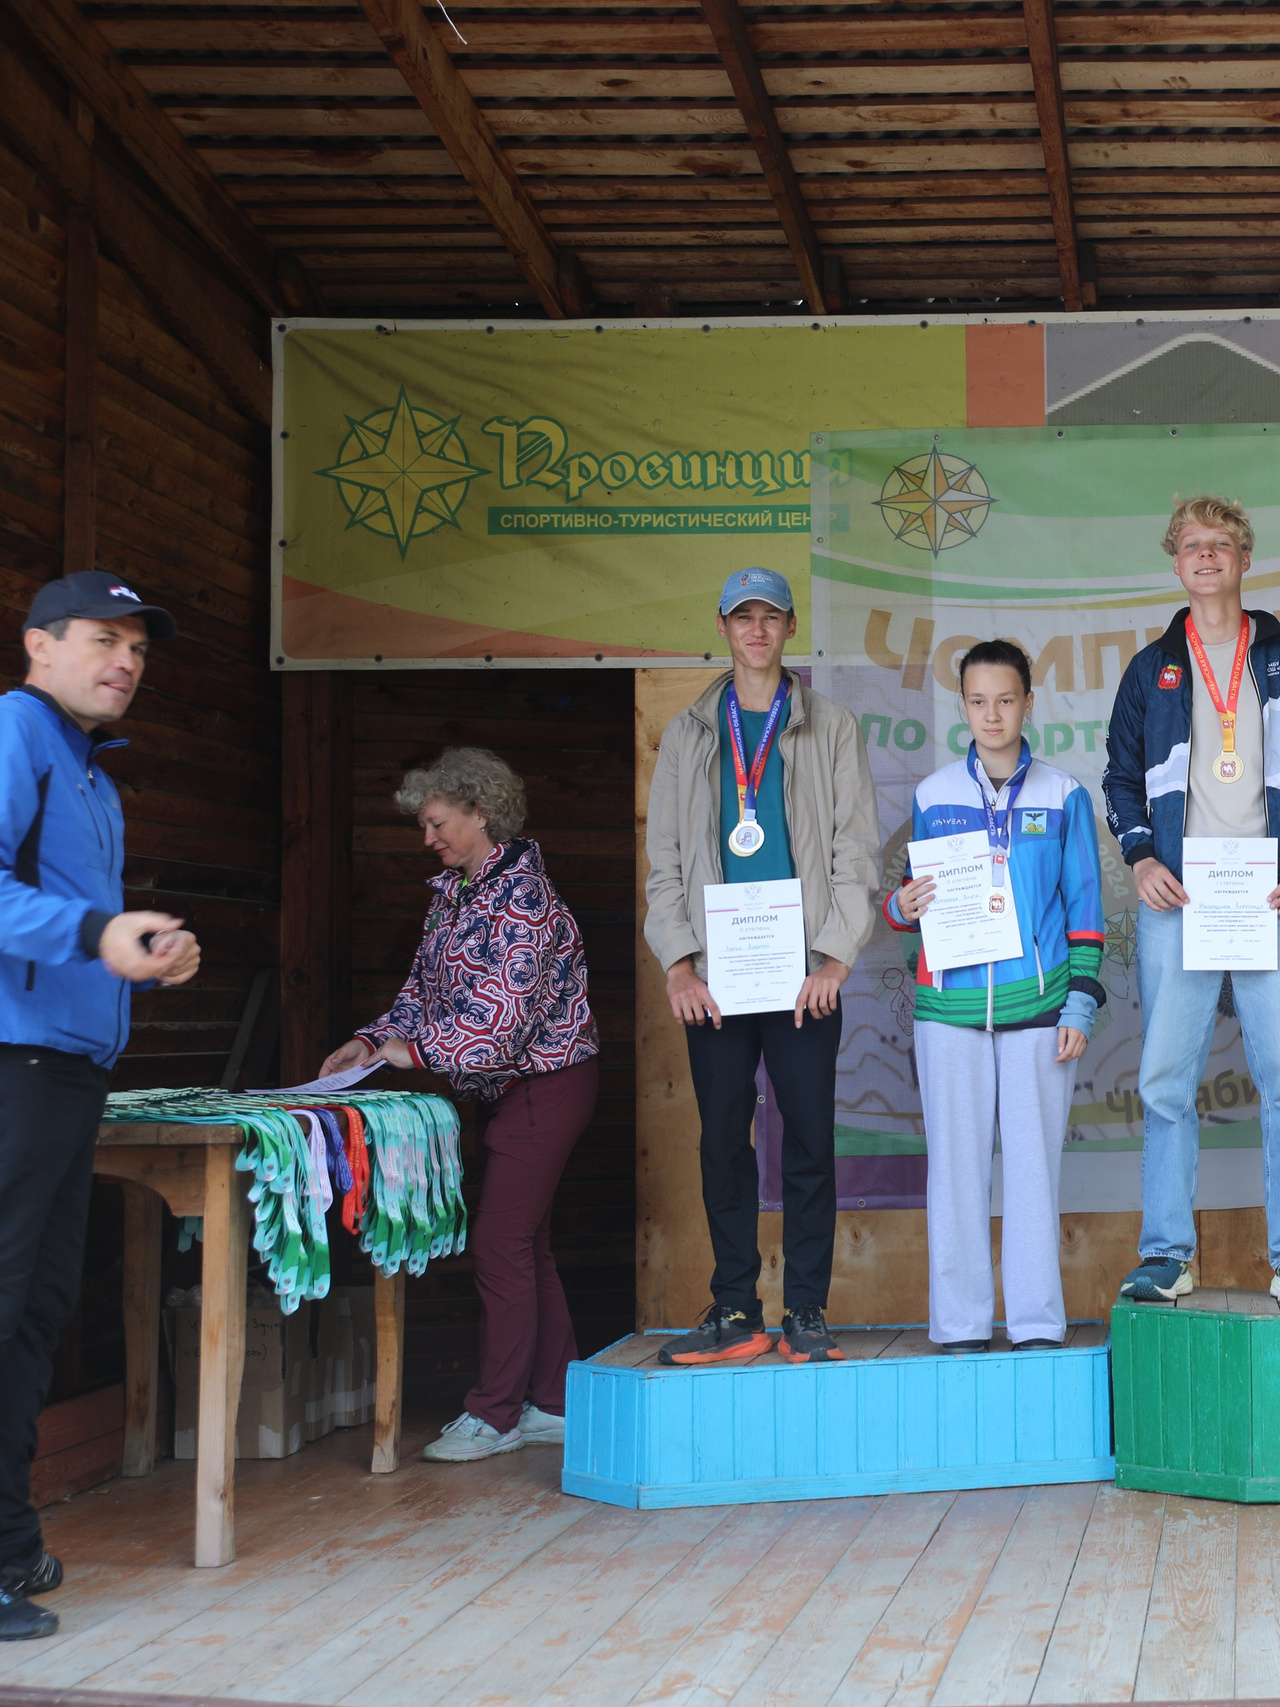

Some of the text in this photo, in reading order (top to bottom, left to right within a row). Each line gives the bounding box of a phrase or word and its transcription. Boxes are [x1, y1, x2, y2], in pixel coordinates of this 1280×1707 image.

[500, 511, 773, 528] СПОРТИВНО-ТУРИСТИЧЕСКИЙ
[938, 864, 983, 878] ДИПЛОМ
[1208, 870, 1253, 878] ДИПЛОМ
[732, 914, 778, 926] ДИПЛОМ
